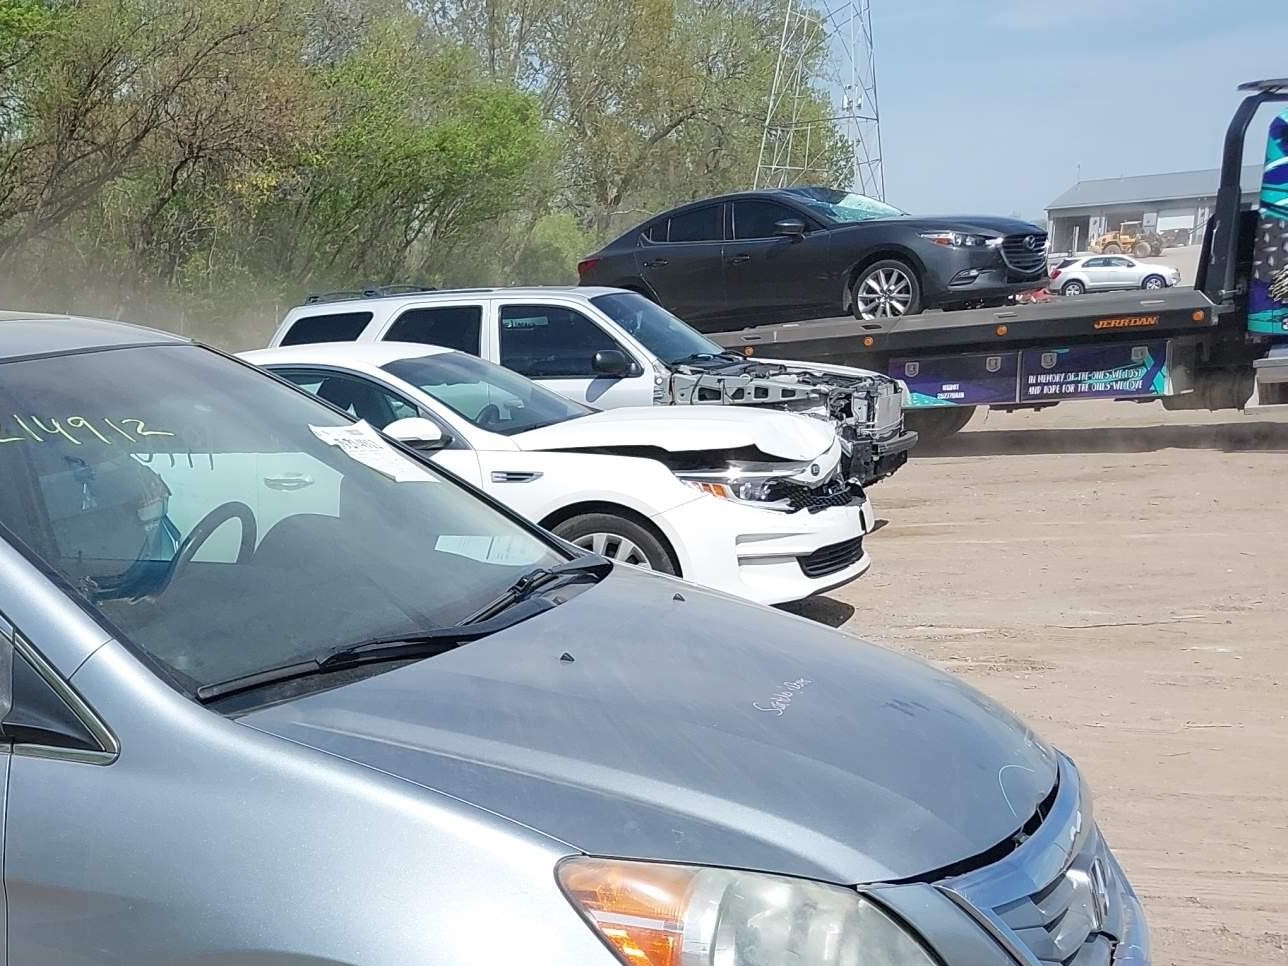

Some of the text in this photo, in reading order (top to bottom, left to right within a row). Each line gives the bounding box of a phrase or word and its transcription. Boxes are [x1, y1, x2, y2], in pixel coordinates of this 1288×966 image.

[1037, 373, 1065, 383] MEMORY
[1028, 385, 1042, 395] AND
[1062, 383, 1076, 393] FOR
